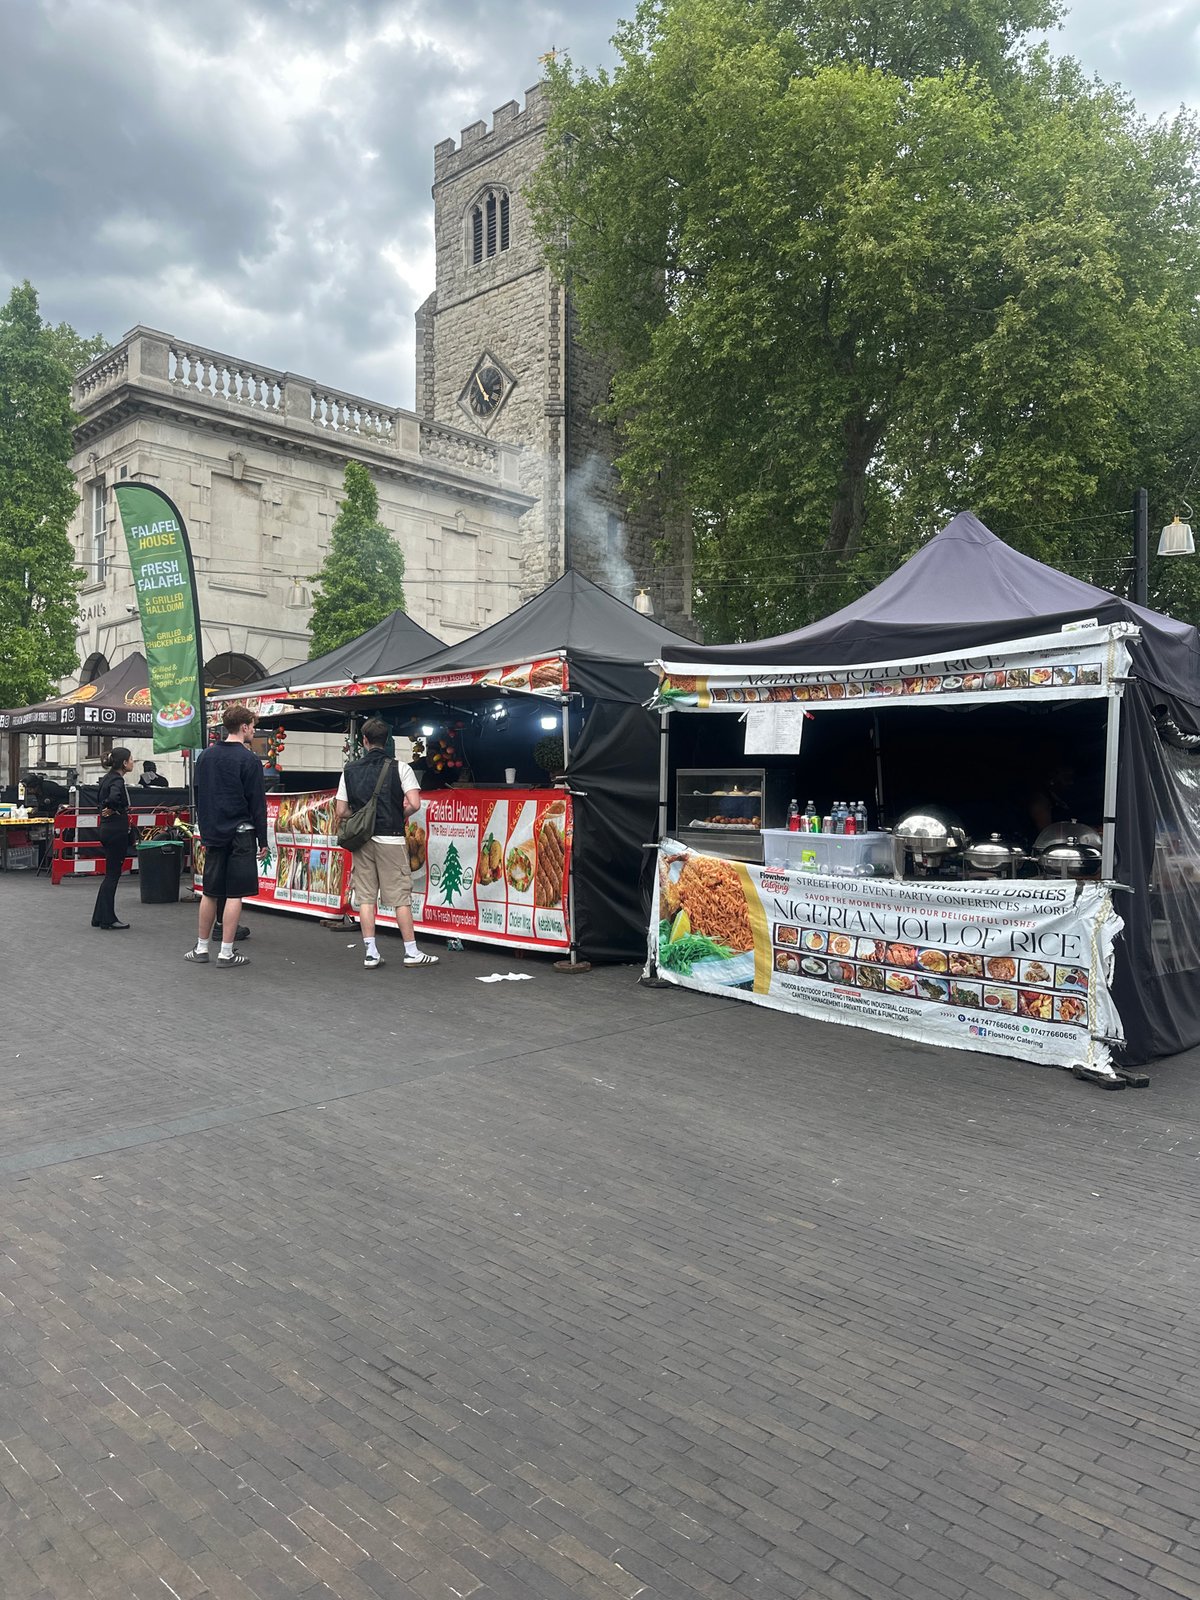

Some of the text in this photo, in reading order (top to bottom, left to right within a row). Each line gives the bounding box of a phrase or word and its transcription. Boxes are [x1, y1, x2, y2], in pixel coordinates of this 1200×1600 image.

[131, 519, 180, 539] FALAFEL
[139, 533, 177, 550] HOUSE
[141, 560, 179, 577] FRESH
[137, 573, 187, 592] FALAFEL
[152, 592, 184, 605] GRILLED
[146, 601, 185, 615] HALLOUMI
[156, 628, 182, 640] GRILLED
[456, 800, 478, 822] House
[759, 871, 790, 882] Flowshow
[804, 893, 1037, 928] SAVOR THE MOMENTS WITH OUR DELIGHTFUL DISHES
[936, 894, 1020, 912] CONFERENCES
[773, 898, 1081, 959] NIGERIAN JOLLOF RICE
[863, 1006, 877, 1015] EVENT
[882, 1010, 909, 1022] FUNCTIONS
[898, 1005, 922, 1017] CATERING
[967, 1016, 1077, 1041] +44 7477660656 07477660656
[987, 1030, 1044, 1049] Floshow Catering
